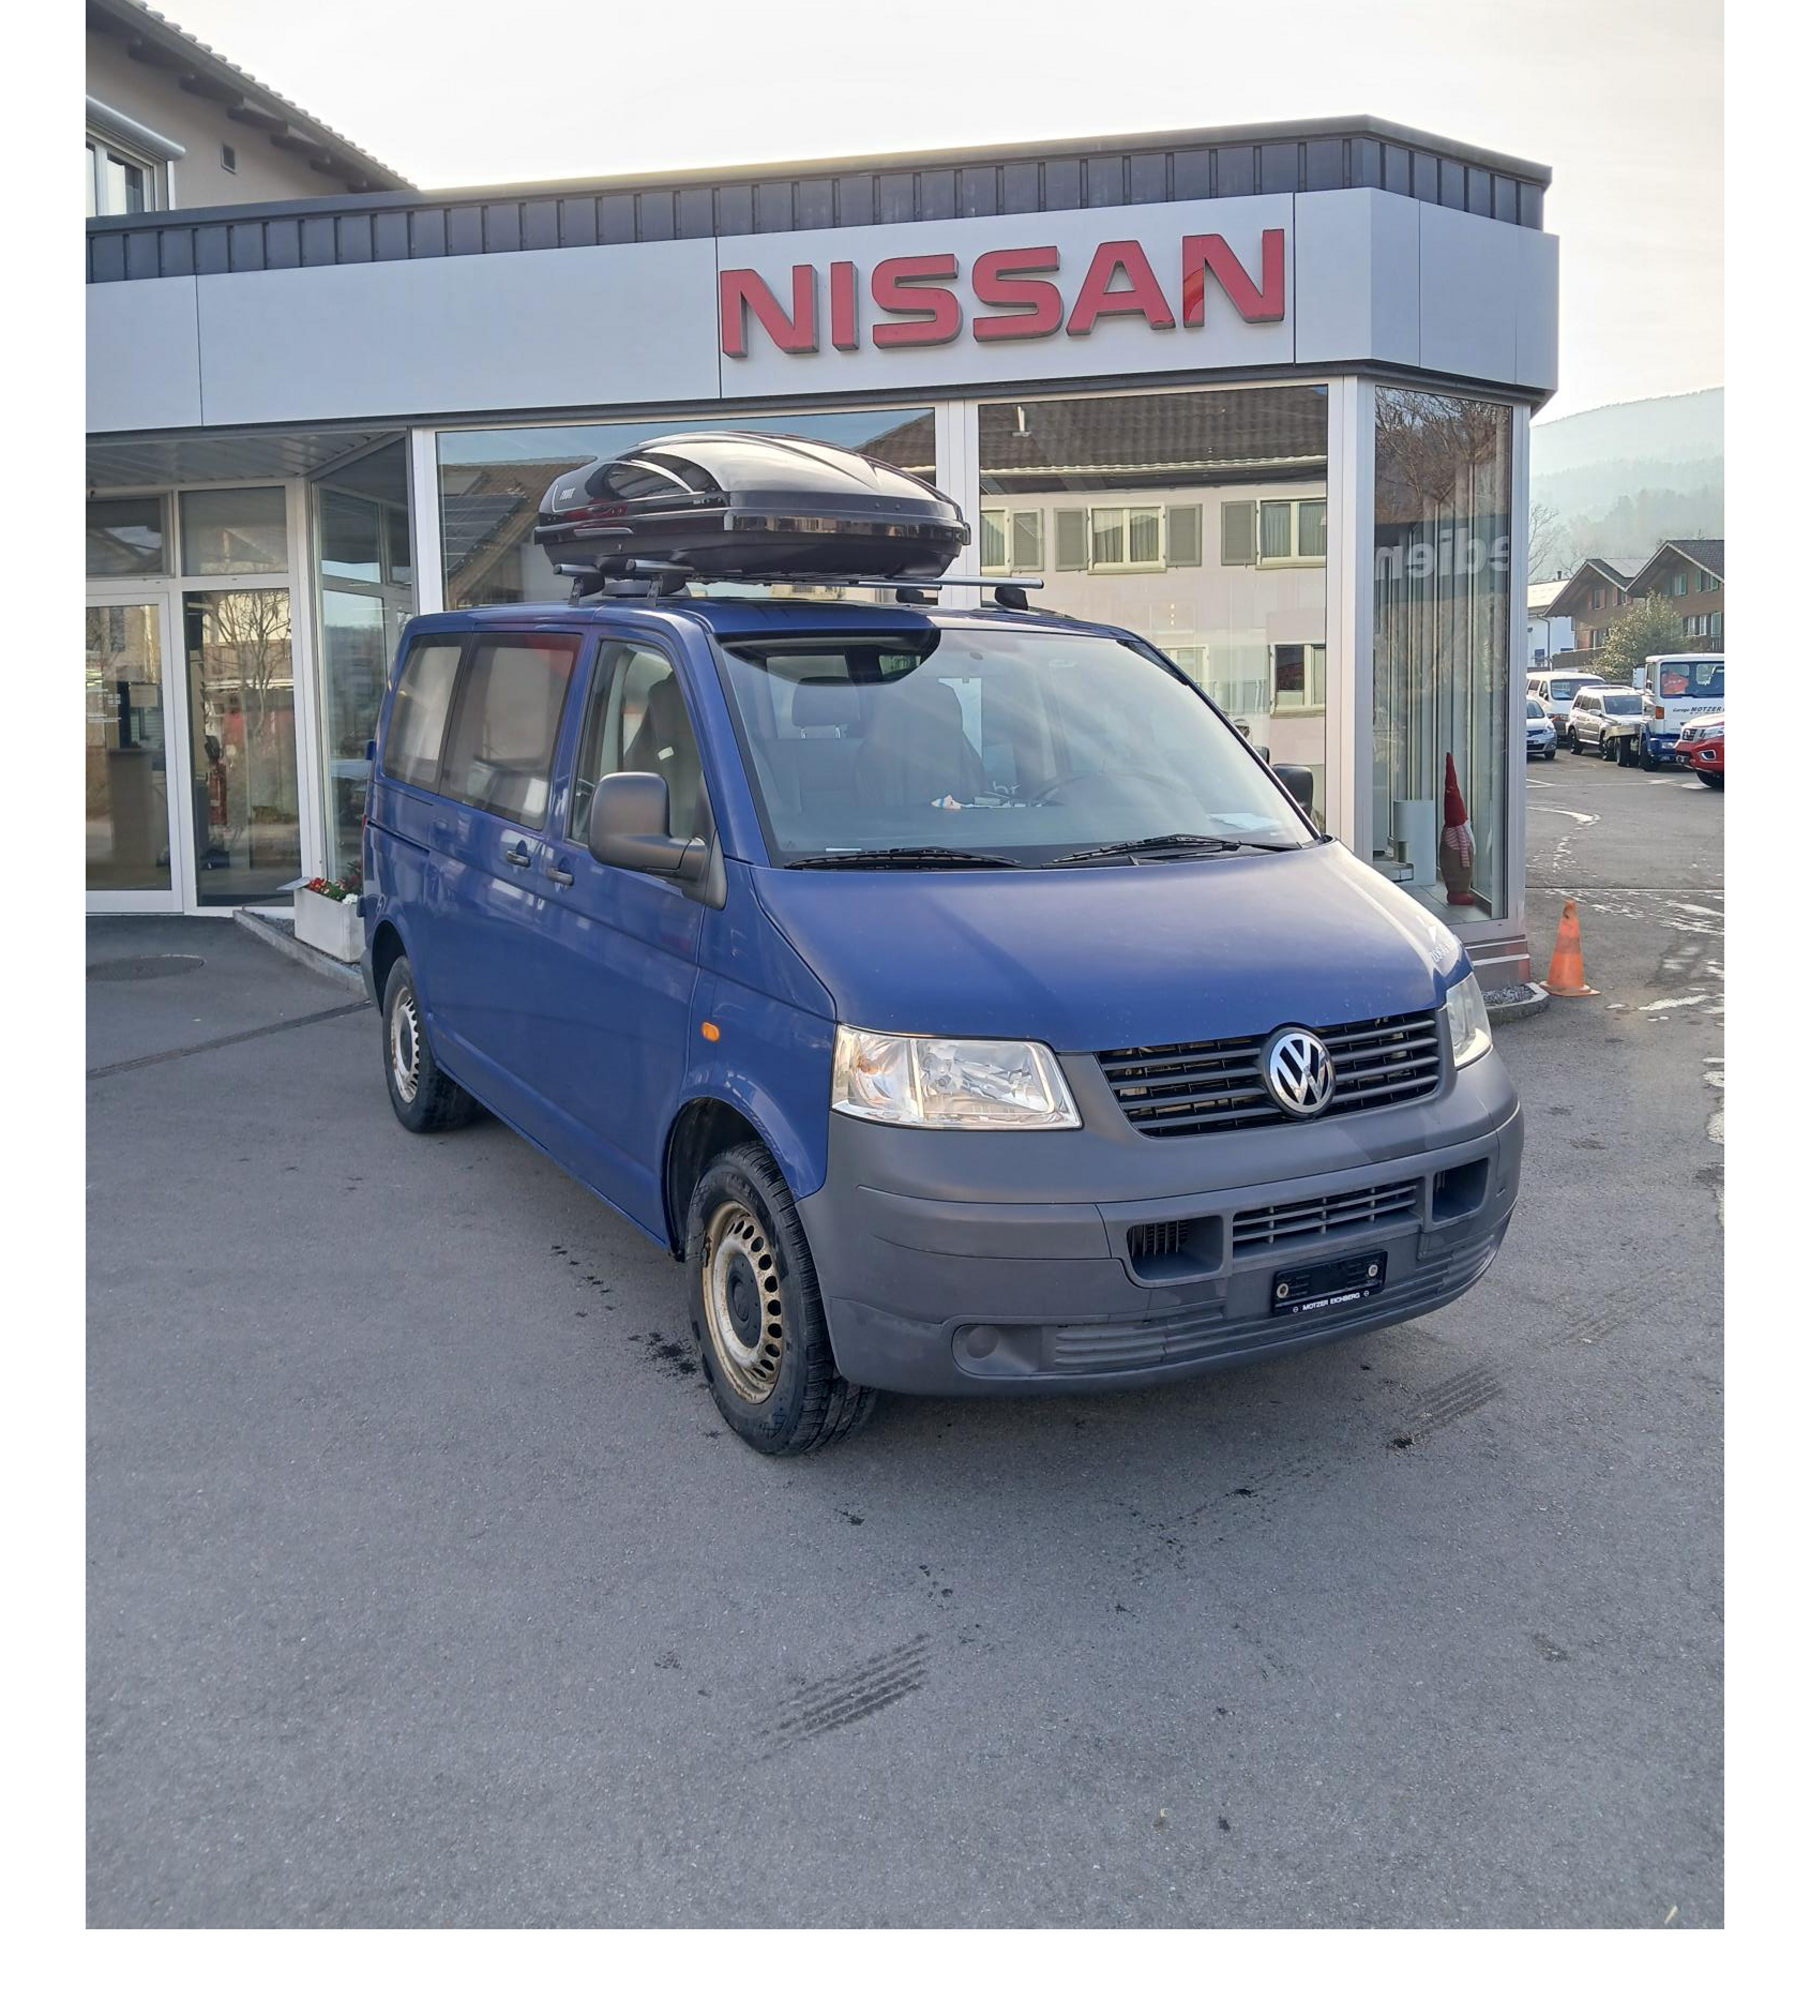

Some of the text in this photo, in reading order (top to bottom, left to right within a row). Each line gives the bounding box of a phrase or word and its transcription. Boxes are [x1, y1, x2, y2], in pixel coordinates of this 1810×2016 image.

[720, 229, 1285, 358] NISSAN
[1302, 1292, 1360, 1311] MOTZER EICHBERG
